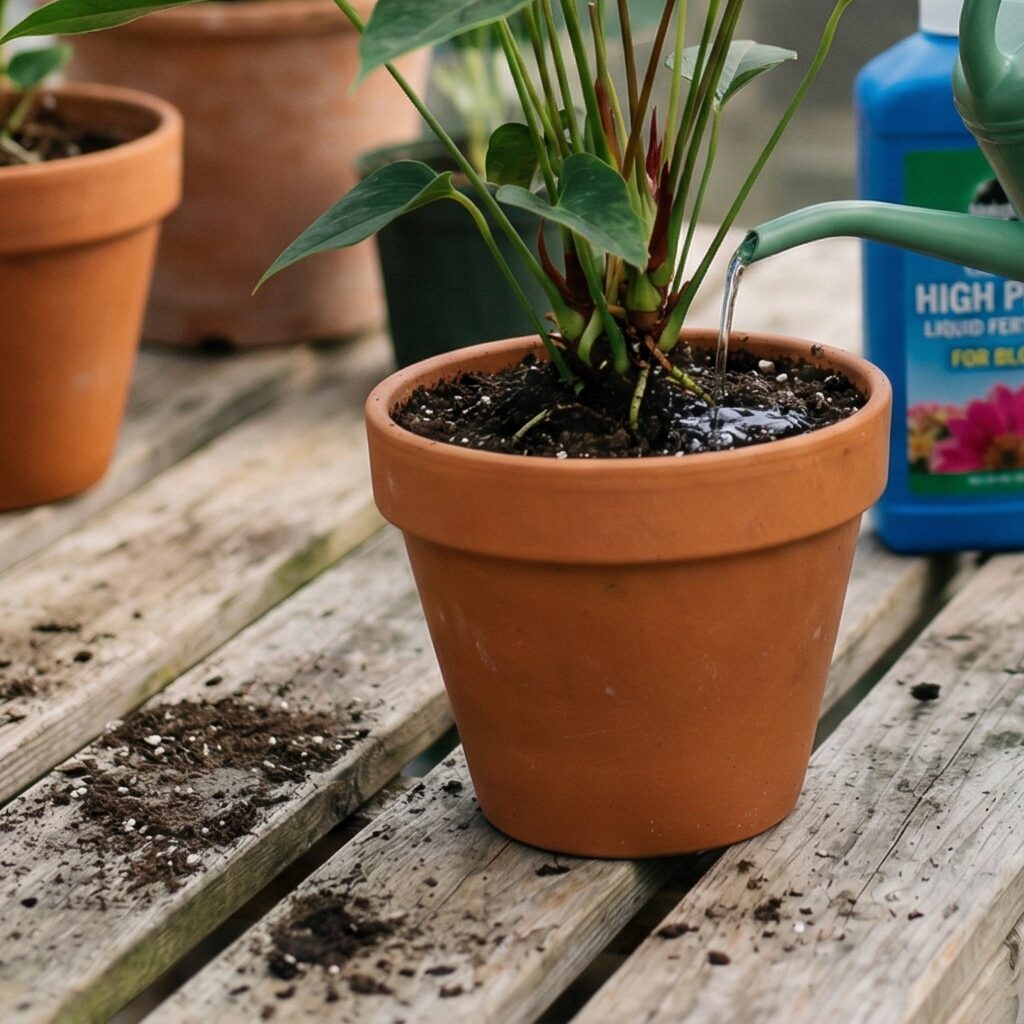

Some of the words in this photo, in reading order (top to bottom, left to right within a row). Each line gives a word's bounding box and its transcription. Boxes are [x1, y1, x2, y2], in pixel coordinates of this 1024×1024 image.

[915, 281, 995, 314] HIGH
[923, 318, 985, 338] LIQUID
[951, 347, 990, 368] FOR
